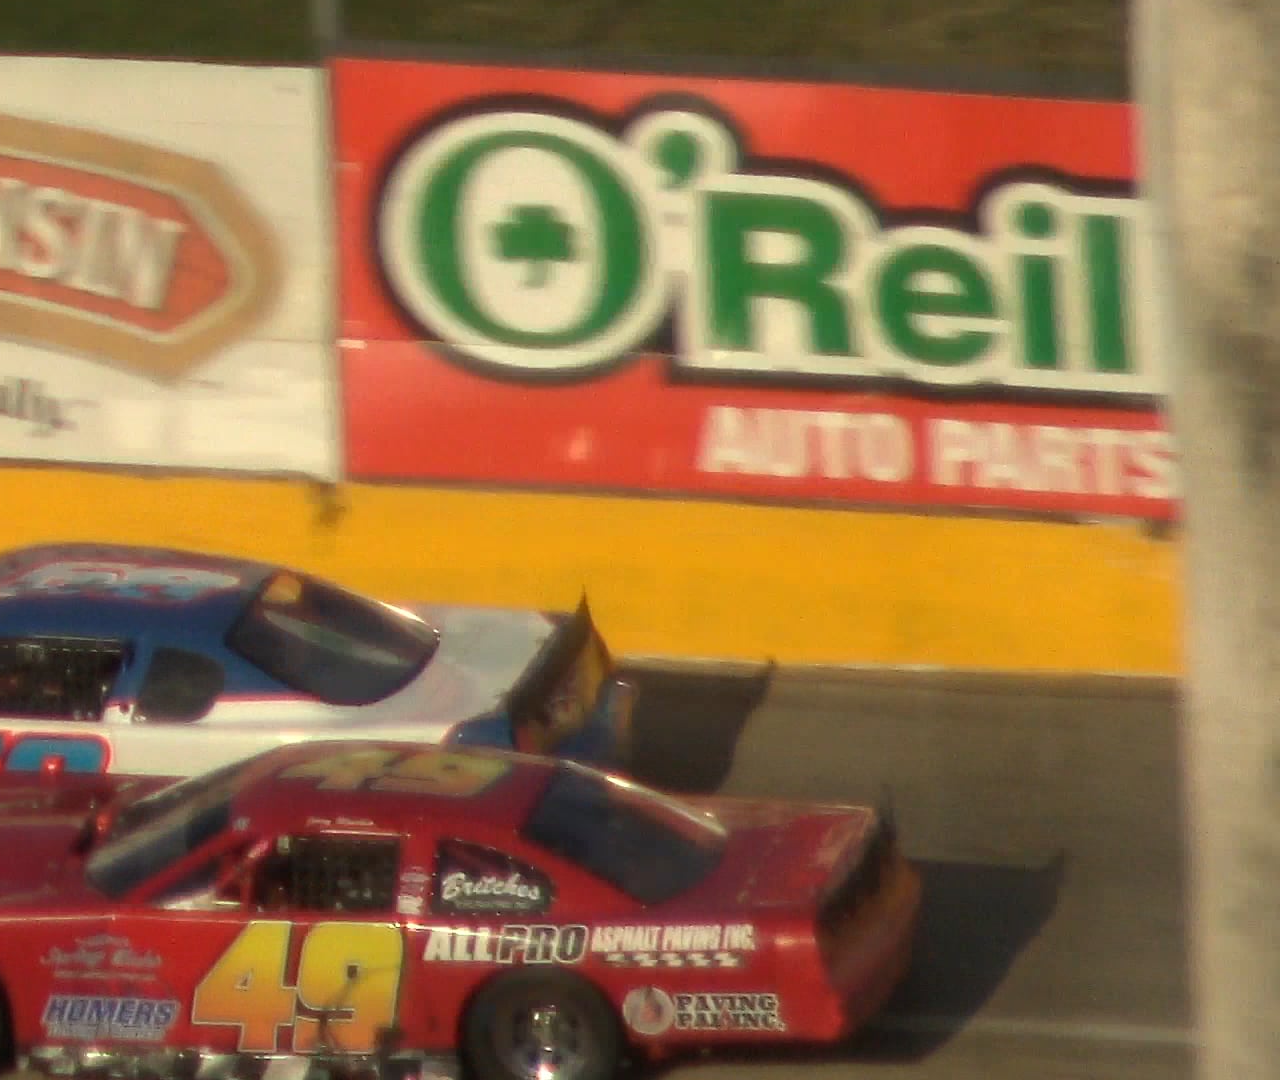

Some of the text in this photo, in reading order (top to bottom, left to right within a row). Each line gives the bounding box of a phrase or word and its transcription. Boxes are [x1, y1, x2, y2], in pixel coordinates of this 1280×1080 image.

[698, 405, 1179, 502] AUTO PARTS
[591, 925, 660, 952] ASPHALT
[662, 925, 722, 952] PAVING
[191, 920, 404, 1053] 49
[675, 994, 778, 1012] PAVING
